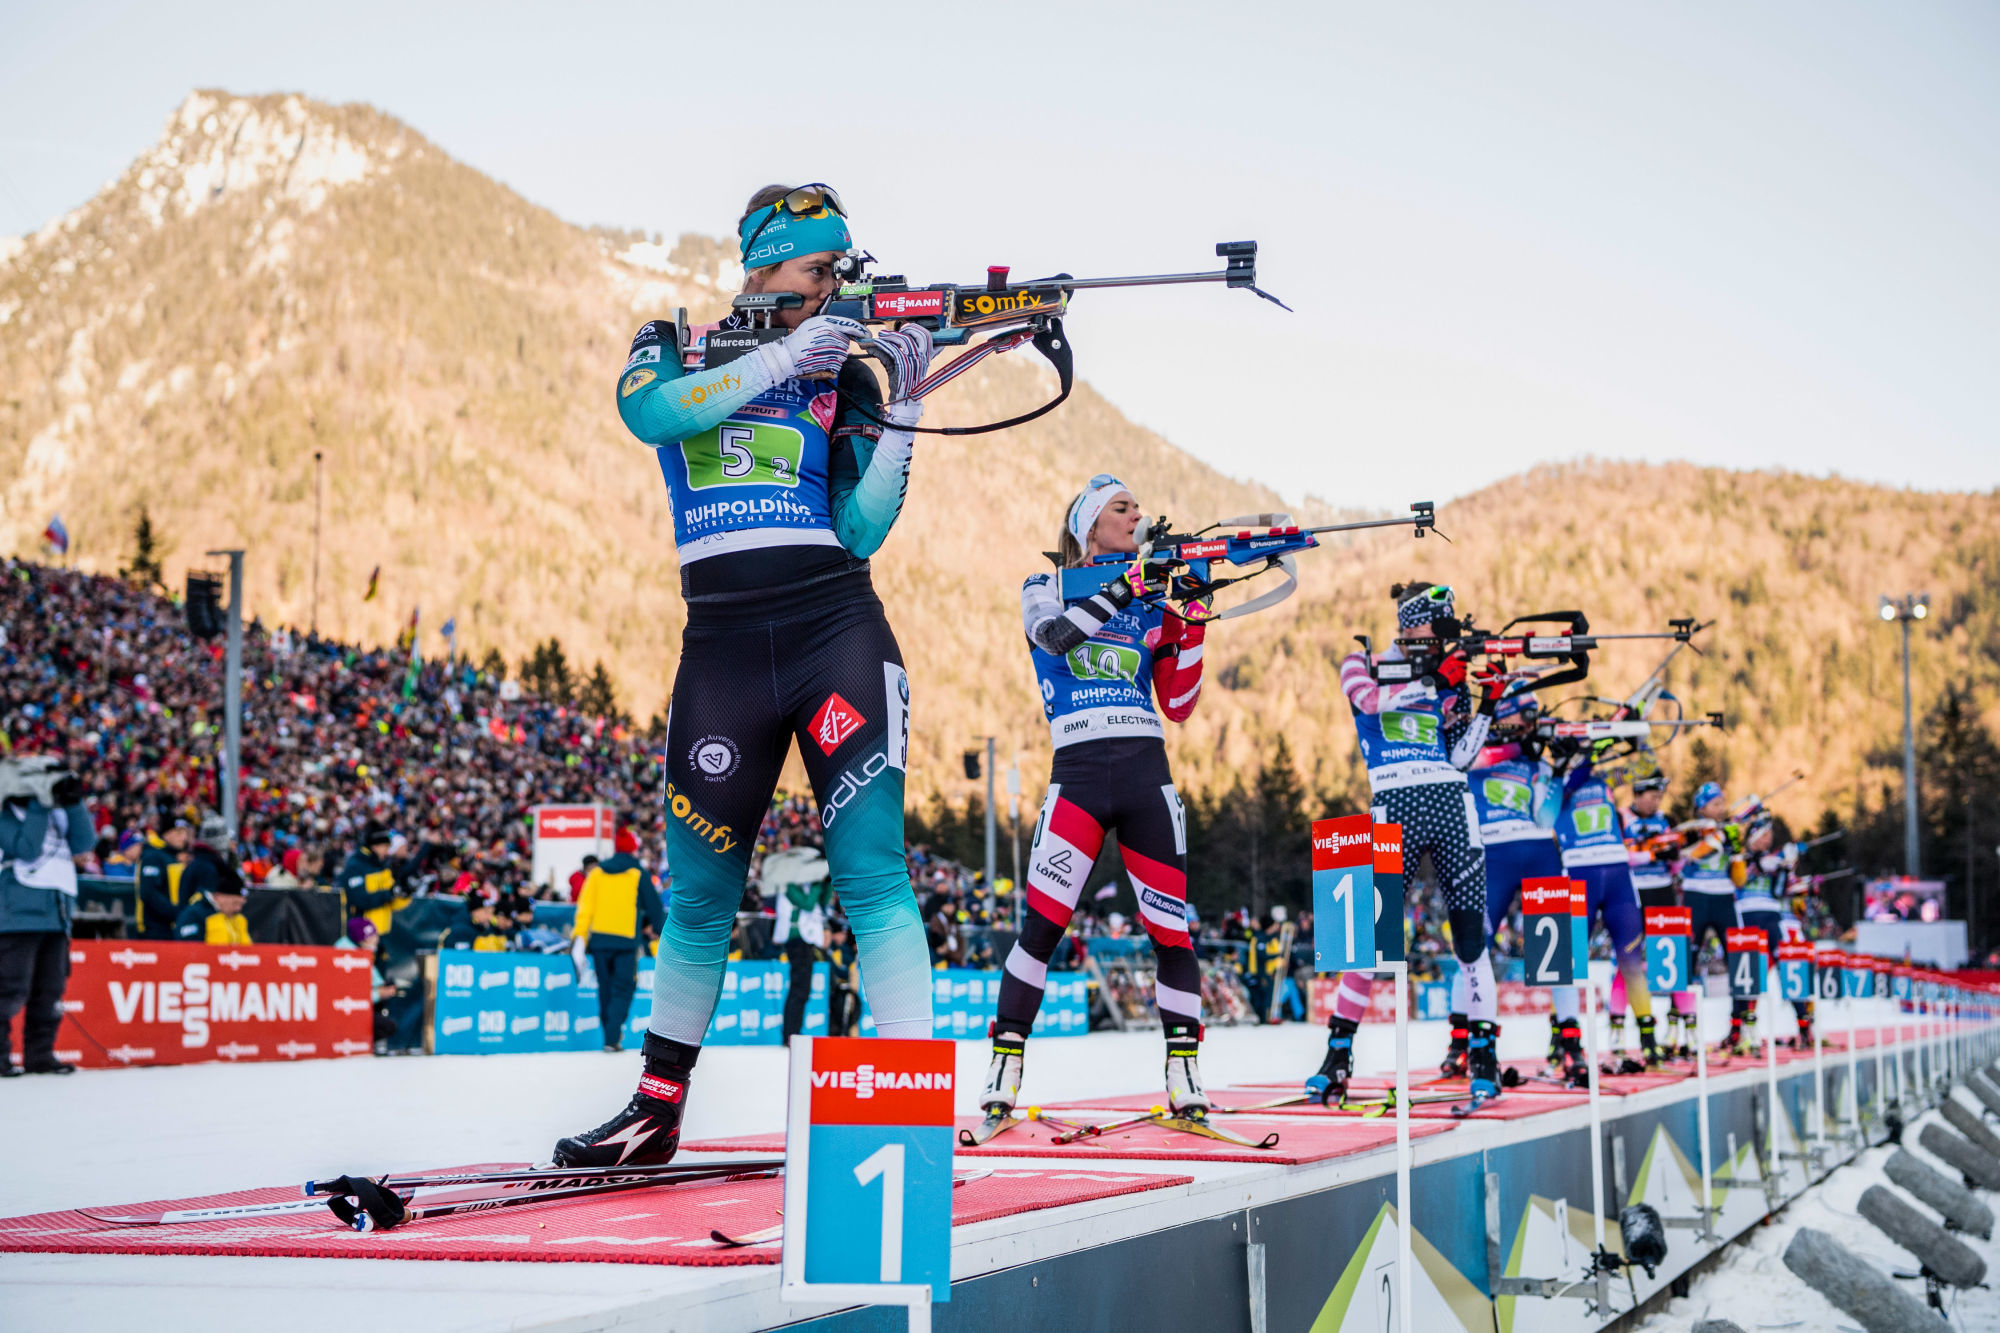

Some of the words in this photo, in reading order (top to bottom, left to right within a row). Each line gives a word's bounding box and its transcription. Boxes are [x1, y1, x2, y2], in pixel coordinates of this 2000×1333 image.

[876, 296, 941, 313] VIESSMANN
[963, 290, 1042, 314] somfy
[710, 338, 759, 348] Marceau
[679, 373, 741, 410] somfy
[719, 425, 755, 479] 5
[772, 456, 793, 482] 2
[684, 498, 812, 526] RUHPOLDING
[686, 514, 764, 534] BAYERISCHE
[775, 514, 816, 524] ALPEN
[1182, 543, 1226, 556] VIESSMANN
[1073, 645, 1121, 677] 10
[1071, 687, 1146, 702] RUHPOLDIN
[1064, 719, 1089, 734] BMW
[1401, 714, 1418, 740] 9
[688, 737, 706, 761] Région
[690, 761, 697, 771] La
[821, 752, 888, 829] odlo
[1502, 784, 1516, 807] 2
[666, 782, 738, 853] somfy
[1313, 832, 1371, 854] VIESSMANN
[1036, 862, 1073, 890] Löffler
[1523, 887, 1570, 904] VIESSMANN
[1333, 874, 1355, 963] 1
[1535, 916, 1560, 982] 2
[1656, 937, 1678, 989] 3
[1734, 952, 1754, 995] 4
[1786, 963, 1803, 999] 5
[1822, 966, 1838, 999] 6
[1854, 969, 1868, 998] 7
[1875, 973, 1888, 998] 8
[107, 963, 318, 1048] VIESSMANN
[811, 1064, 953, 1099] VIESSMANN
[853, 1143, 906, 1283] 1
